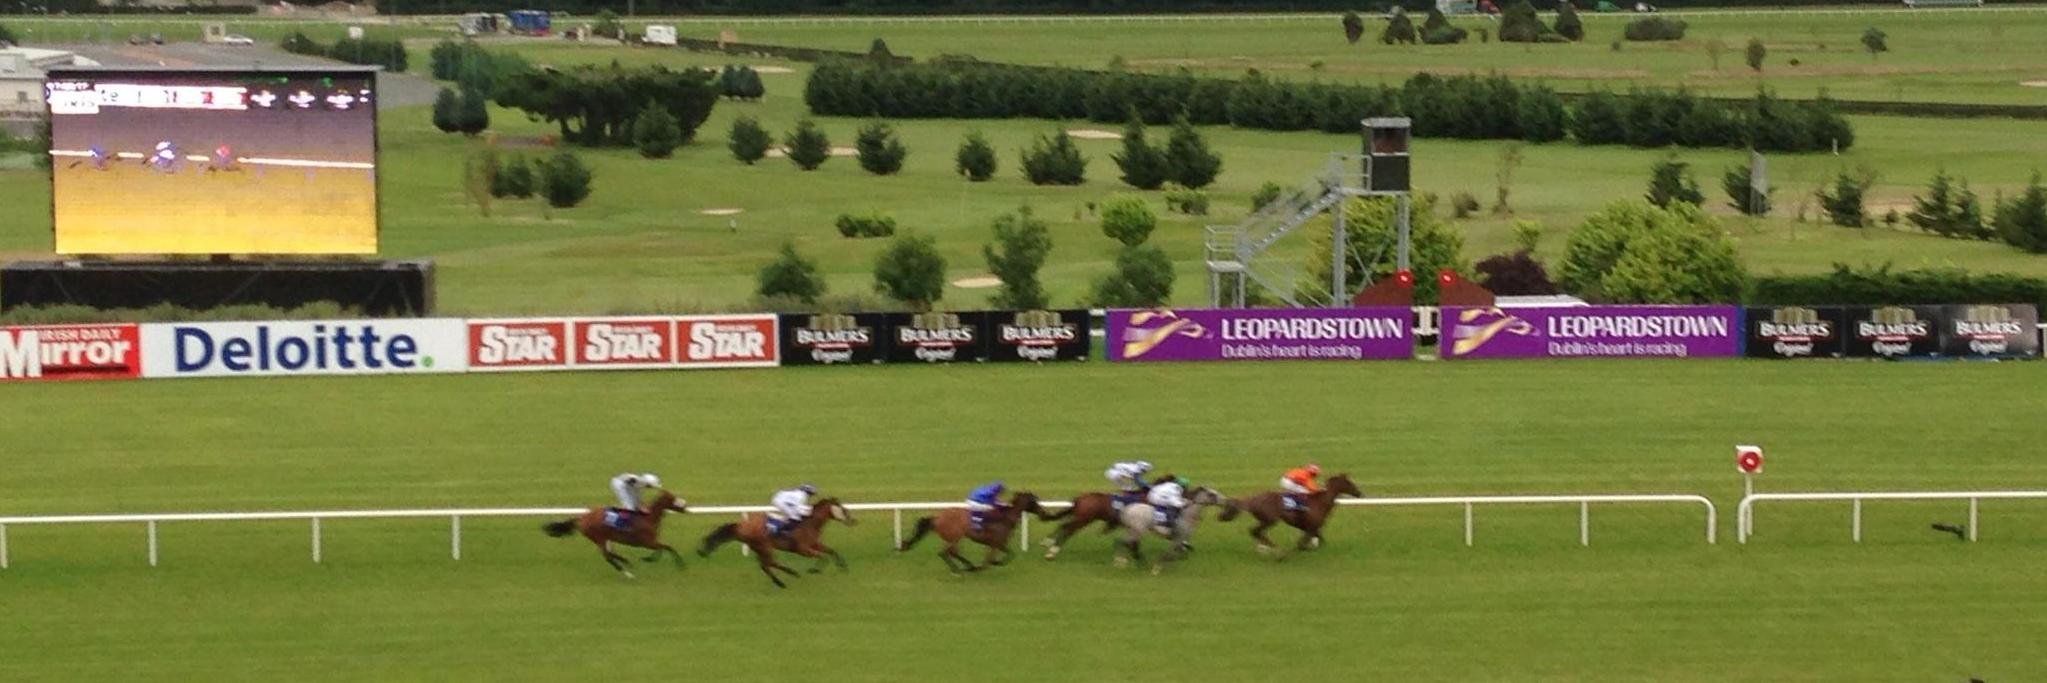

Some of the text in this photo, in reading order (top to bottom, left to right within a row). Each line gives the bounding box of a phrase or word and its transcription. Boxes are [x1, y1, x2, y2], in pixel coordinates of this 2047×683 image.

[899, 326, 973, 343] BULMERS
[1002, 324, 1075, 342] BULMERS
[1221, 318, 1403, 340] LEOPARDSTOWN
[1548, 315, 1728, 338] LEOPARDSTOWN
[1759, 321, 1830, 338] BULMERS
[1858, 320, 1928, 337] BULMERS
[1955, 319, 2022, 336] BULMERS
[796, 327, 869, 344] BULMERS
[0, 329, 131, 378] Mirror
